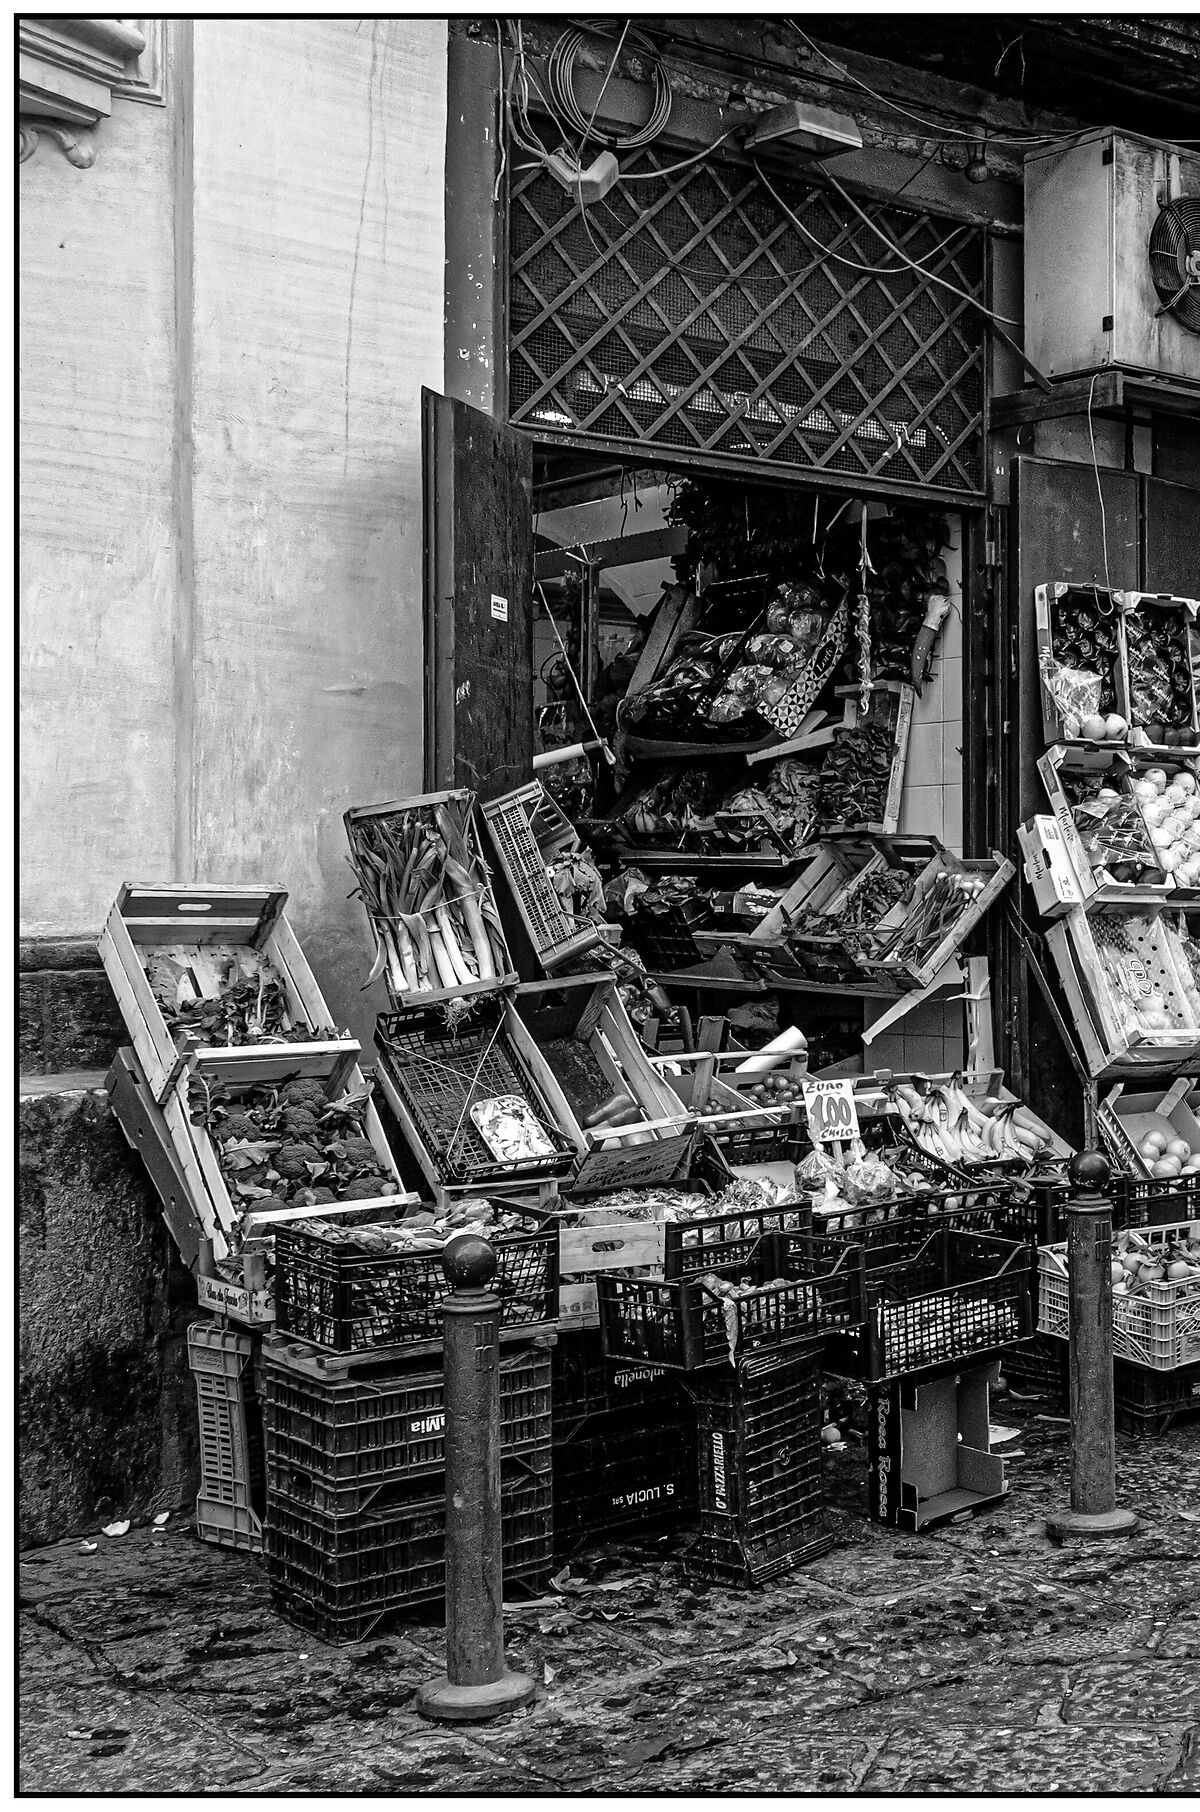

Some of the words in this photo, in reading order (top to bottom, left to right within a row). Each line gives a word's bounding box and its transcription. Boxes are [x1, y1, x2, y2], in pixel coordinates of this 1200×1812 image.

[805, 1082, 843, 1094] EURO
[877, 1398, 891, 1449] Rosa
[712, 1432, 726, 1497] PAZZARIELLO
[626, 1487, 661, 1506] LUCIA
[664, 1483, 675, 1496] S.
[877, 1455, 892, 1517] Rossa
